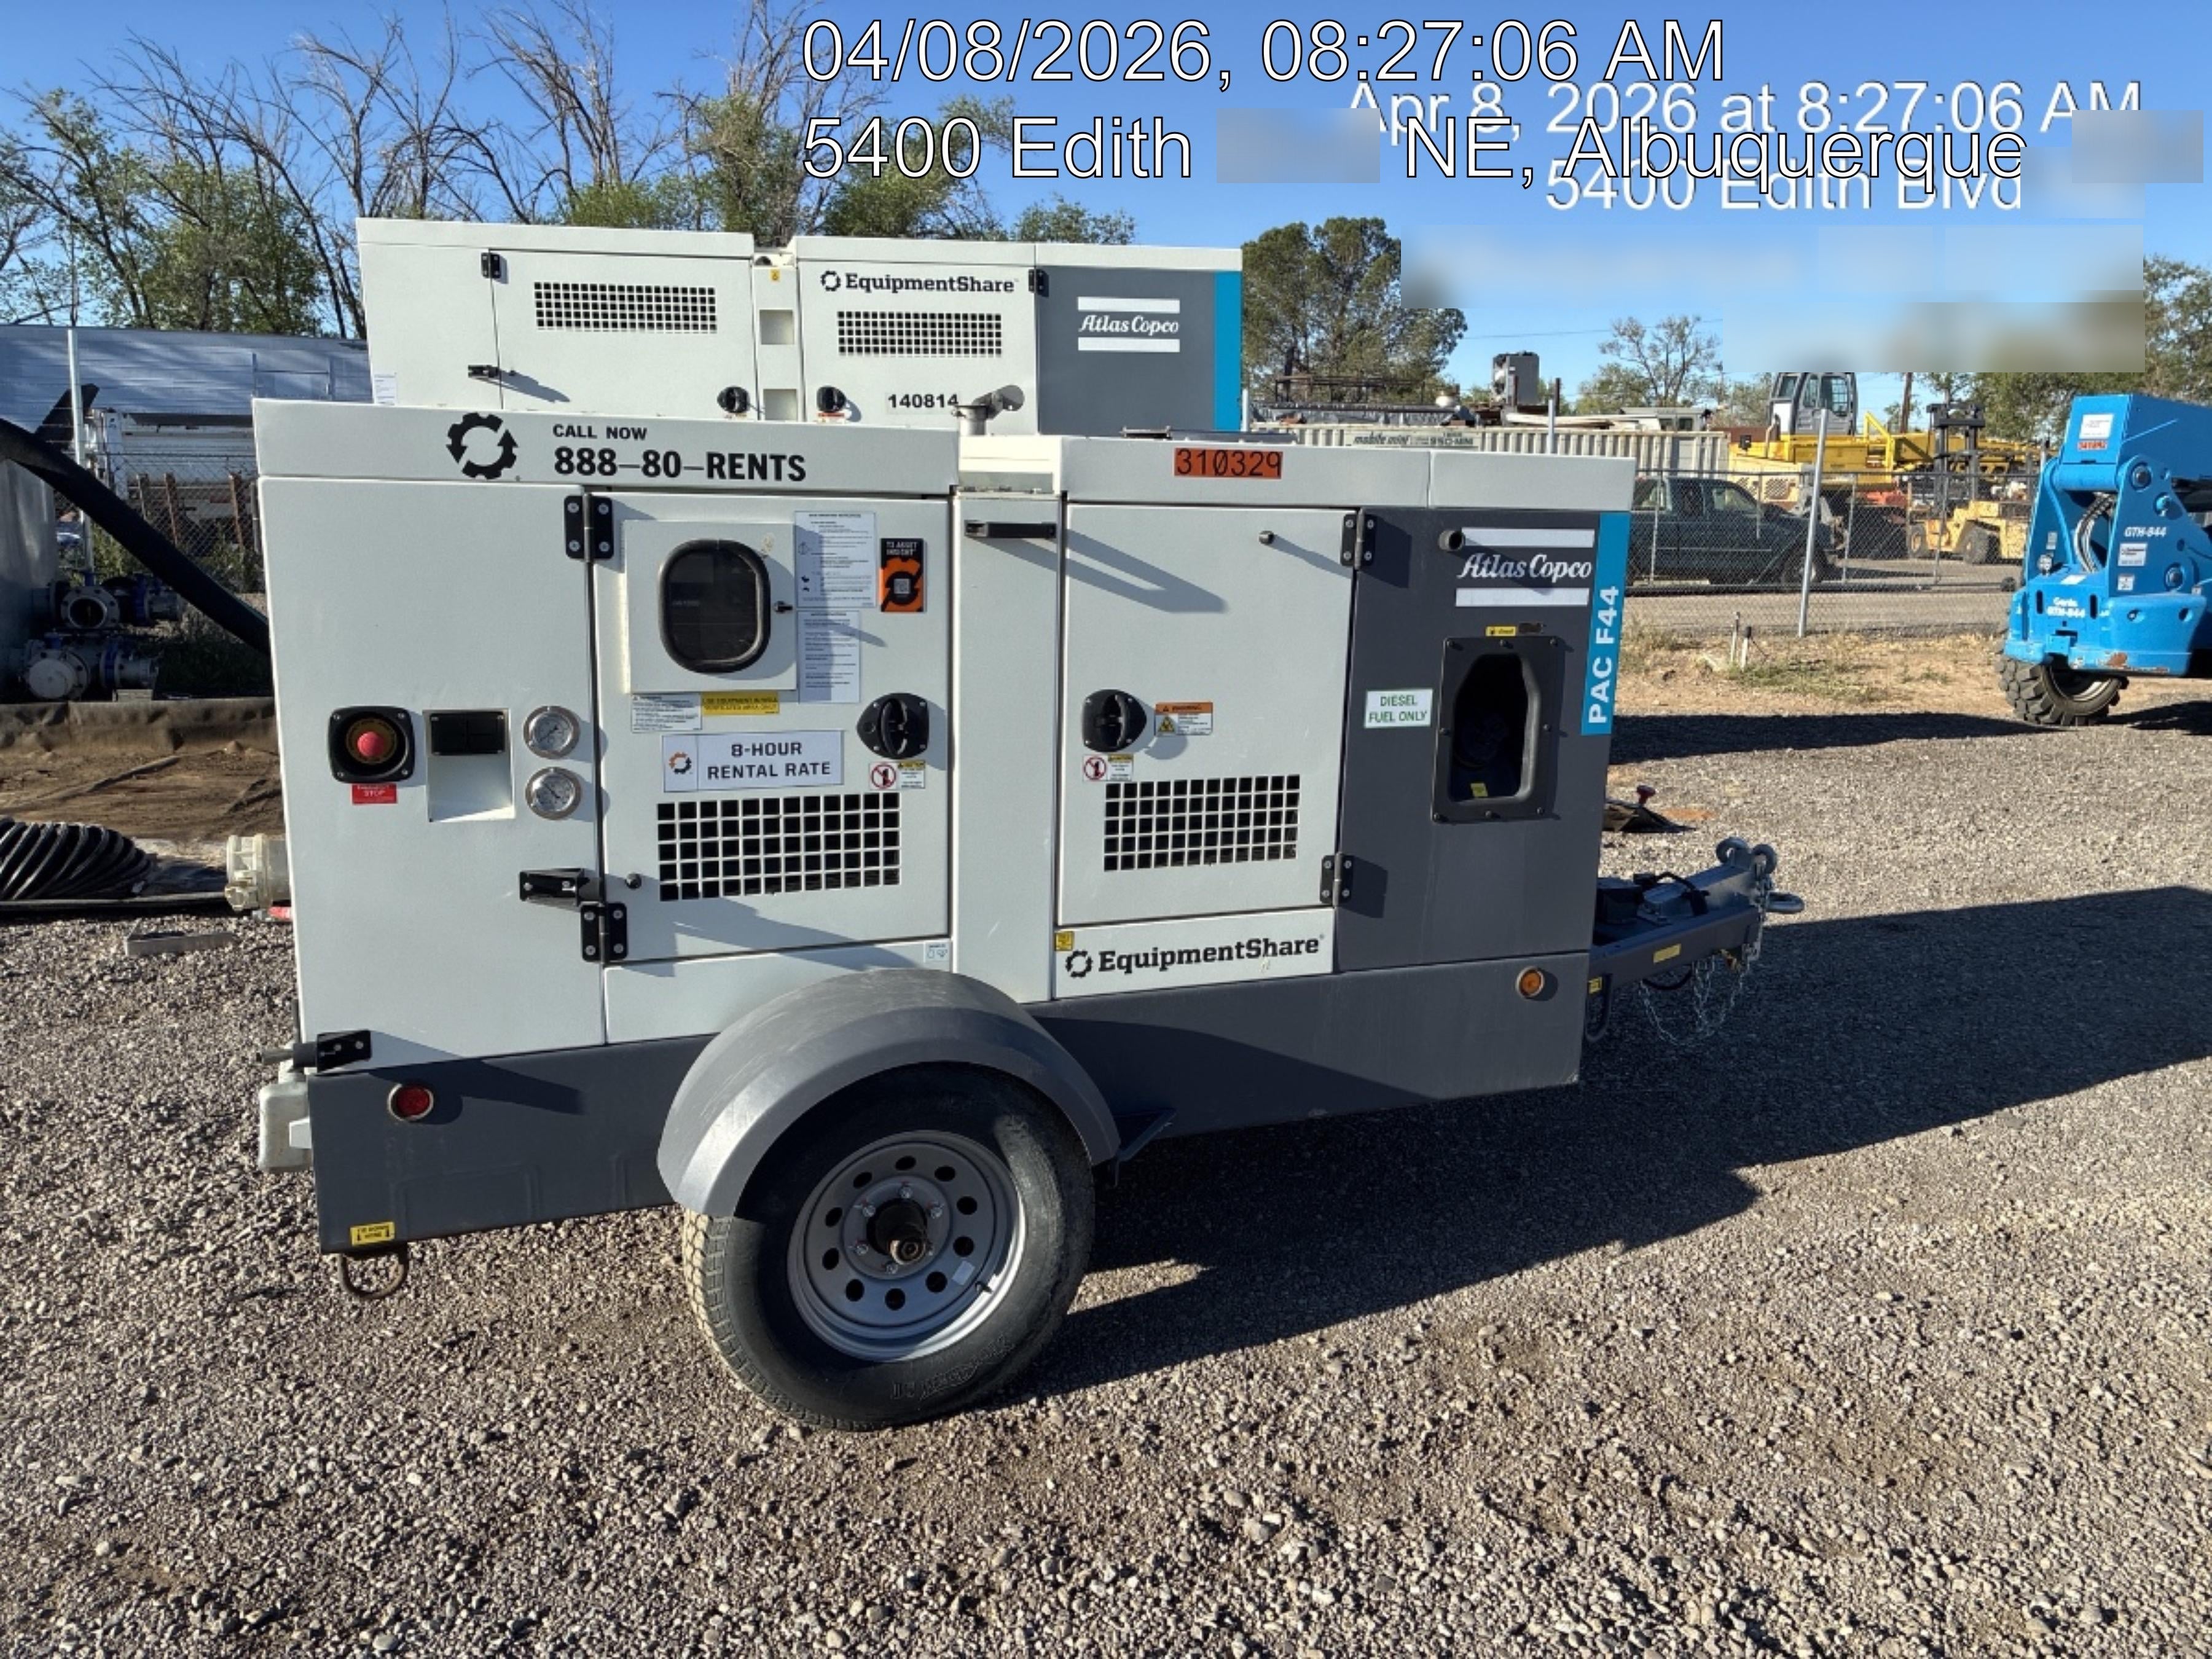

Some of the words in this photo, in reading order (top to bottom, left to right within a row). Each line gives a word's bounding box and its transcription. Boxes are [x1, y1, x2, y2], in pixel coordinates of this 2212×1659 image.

[845, 273, 1015, 293] EquipmentShare
[1078, 314, 1129, 332] Atlas
[1131, 315, 1179, 336] Copco
[888, 394, 959, 408] 140814
[553, 424, 597, 439] CALL
[606, 426, 647, 440] NOW
[554, 446, 806, 482] 888-80-RENTS
[1177, 448, 1282, 476] 310329
[1456, 553, 1527, 579] Atlas
[1529, 554, 1592, 583] Copco
[1595, 586, 1620, 644] F44
[1588, 656, 1612, 723] PAC
[1380, 694, 1418, 707] DIESEL
[1368, 712, 1395, 723] FUEL
[1398, 710, 1427, 721] ONLY
[731, 742, 802, 757] 8-HOUR
[708, 764, 778, 780] RENTAL
[785, 762, 831, 777] RATE
[1099, 938, 1319, 975] EquipmentShare
